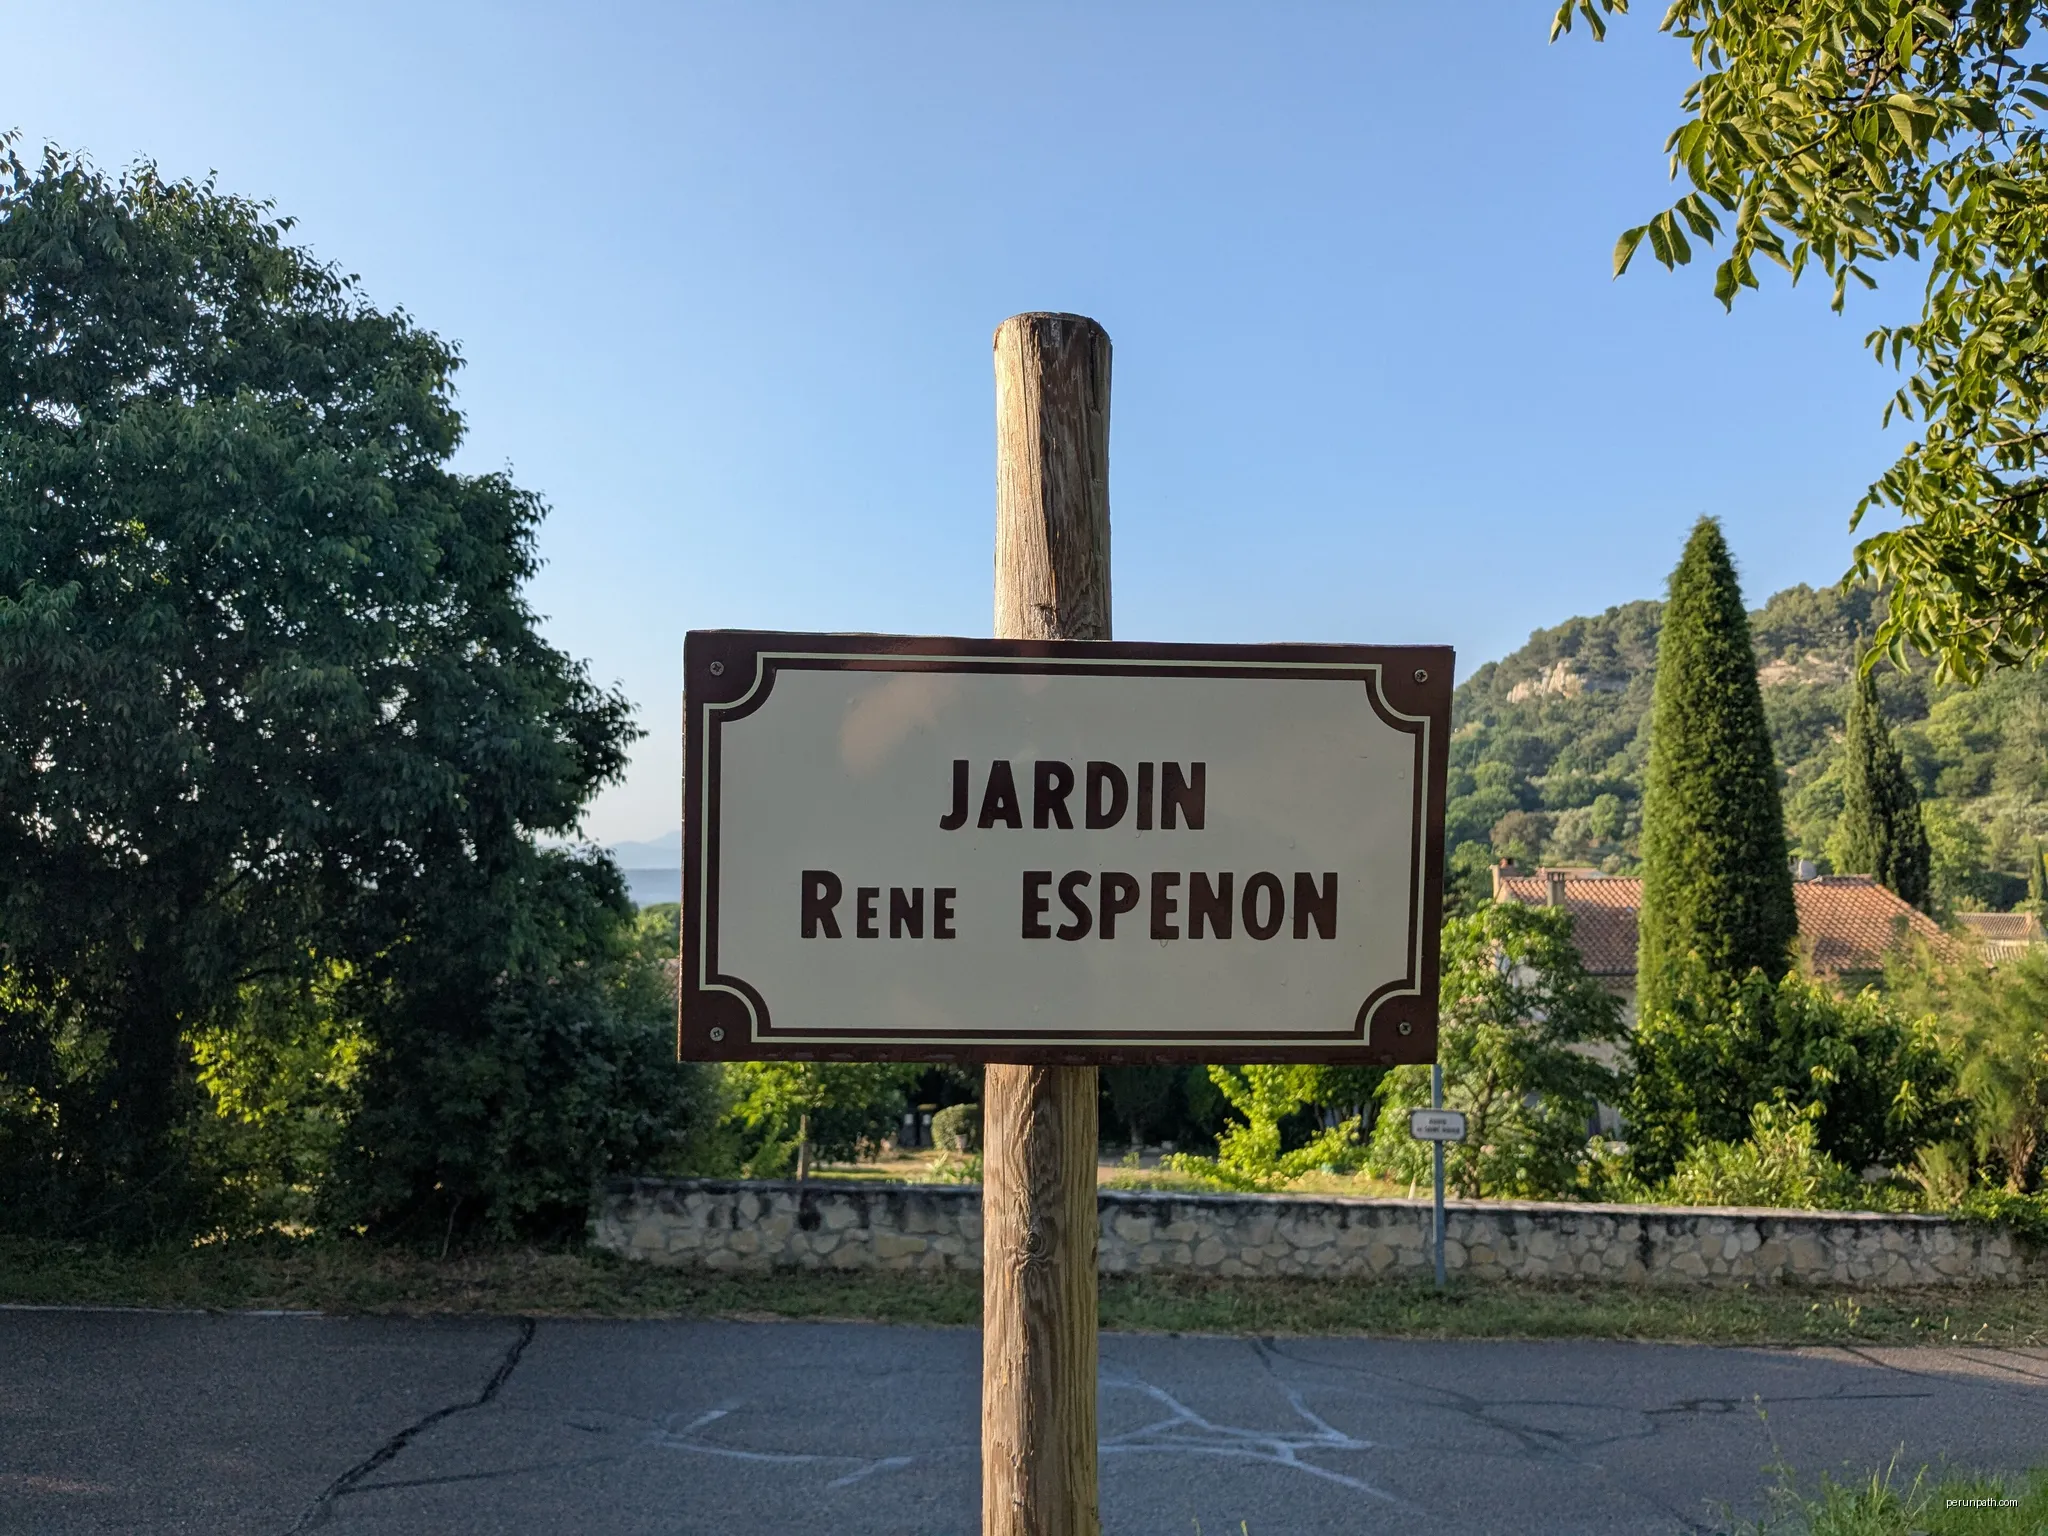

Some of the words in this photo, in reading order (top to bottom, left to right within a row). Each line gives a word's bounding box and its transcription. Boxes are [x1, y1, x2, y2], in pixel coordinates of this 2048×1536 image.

[939, 760, 1206, 831] JARDIN
[801, 870, 957, 939] RENE
[1022, 871, 1338, 940] ESPENON
